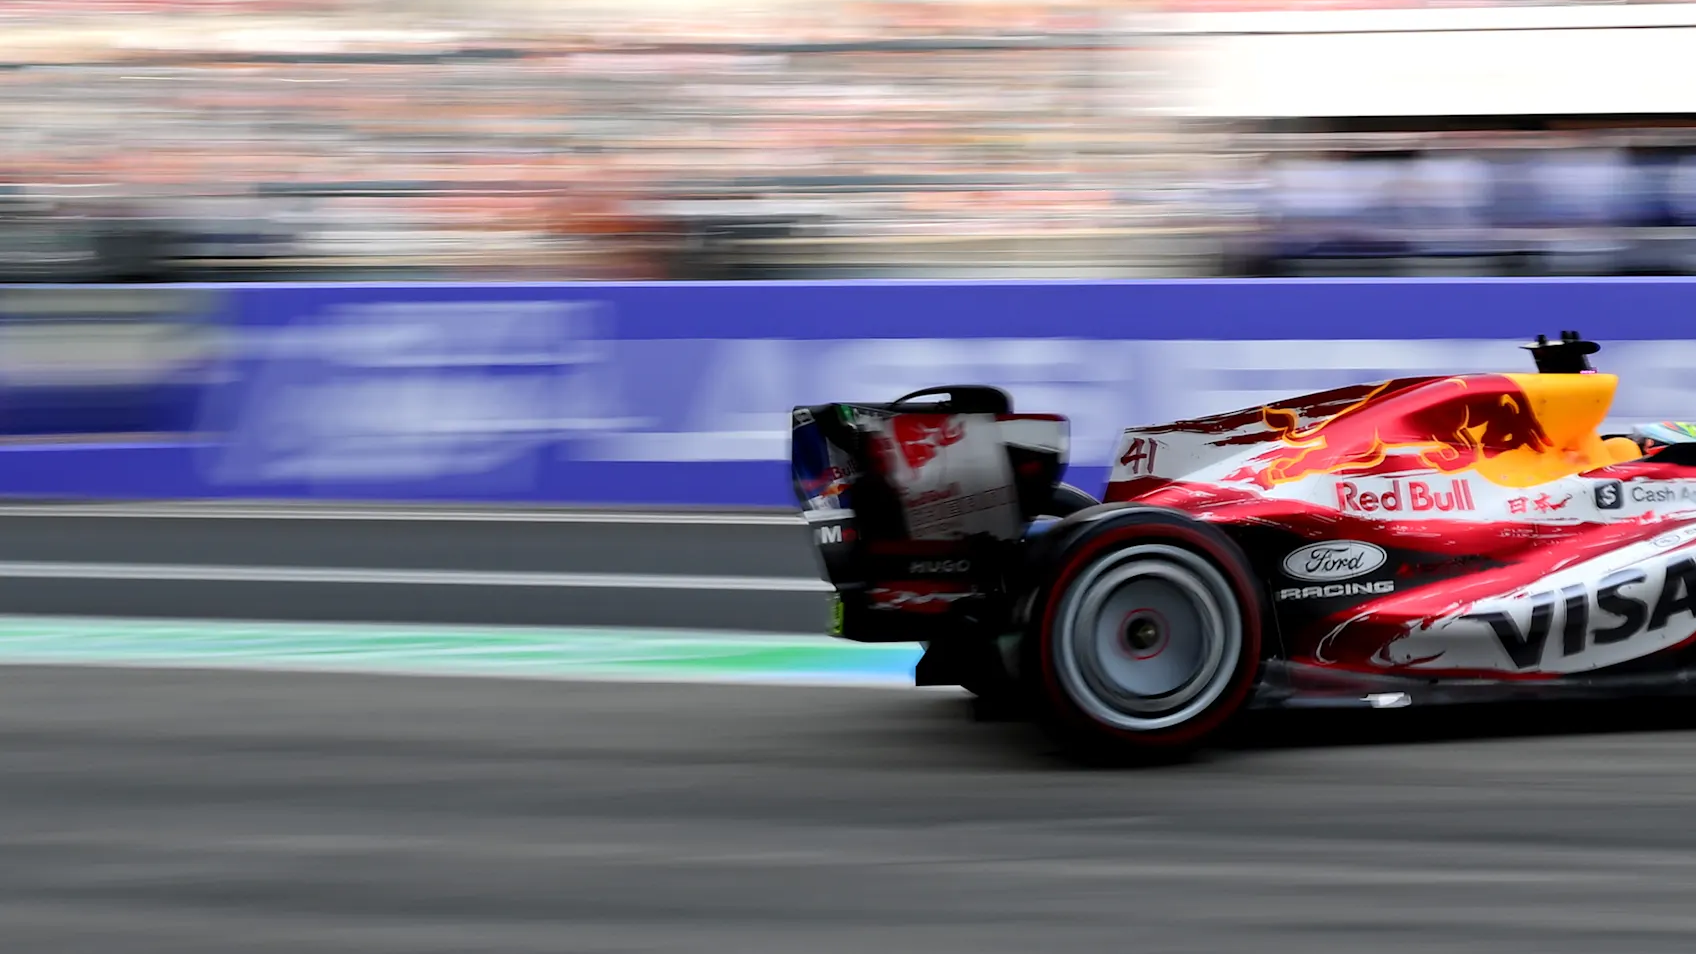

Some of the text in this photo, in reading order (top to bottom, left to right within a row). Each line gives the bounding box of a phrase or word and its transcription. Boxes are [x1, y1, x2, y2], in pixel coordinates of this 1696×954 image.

[1120, 437, 1157, 474] 41
[1335, 479, 1476, 513] Red Bull
[1631, 486, 1675, 503] Cash
[909, 559, 971, 574] HUGO
[1304, 547, 1365, 573] Ford
[1277, 580, 1395, 601] RACING
